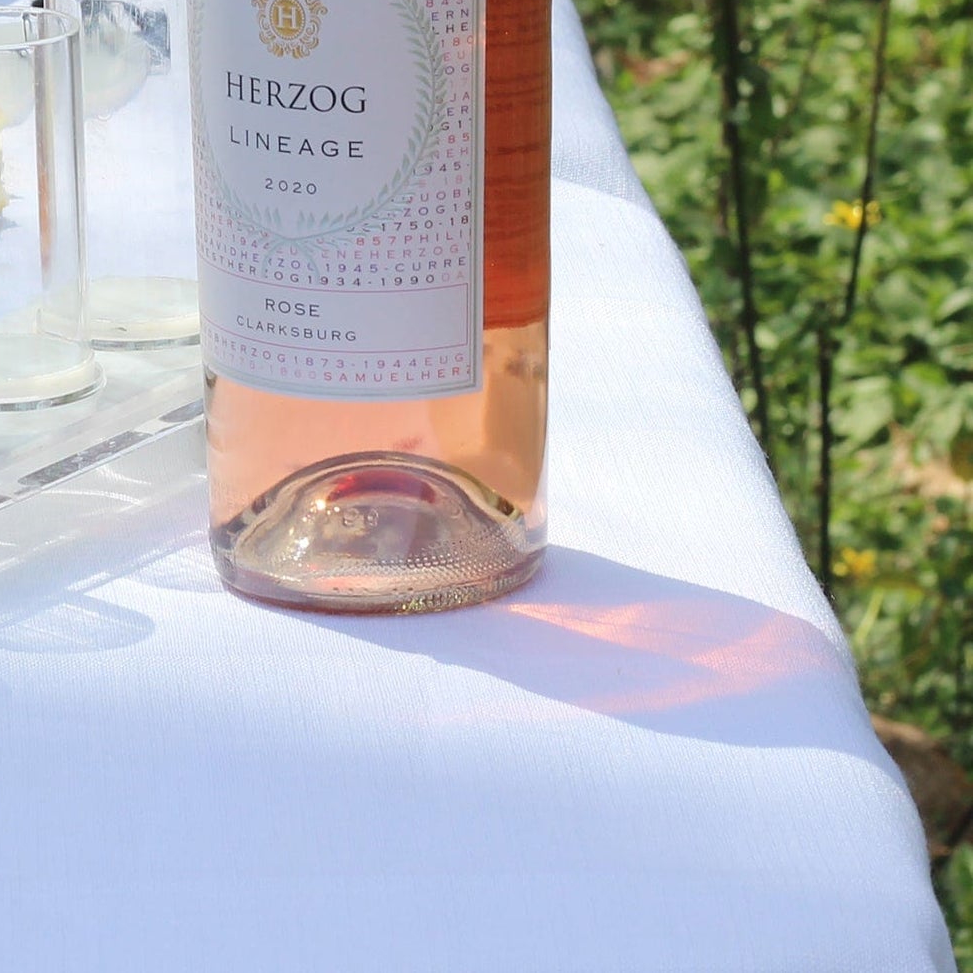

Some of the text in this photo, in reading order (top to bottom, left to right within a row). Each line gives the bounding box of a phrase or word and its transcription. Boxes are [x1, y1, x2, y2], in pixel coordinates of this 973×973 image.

[227, 71, 367, 114] HERZOG
[230, 125, 364, 158] LINEAGE
[265, 178, 317, 195] 2020
[265, 298, 320, 317] ROSE
[236, 315, 357, 341] CLARKSBURG
